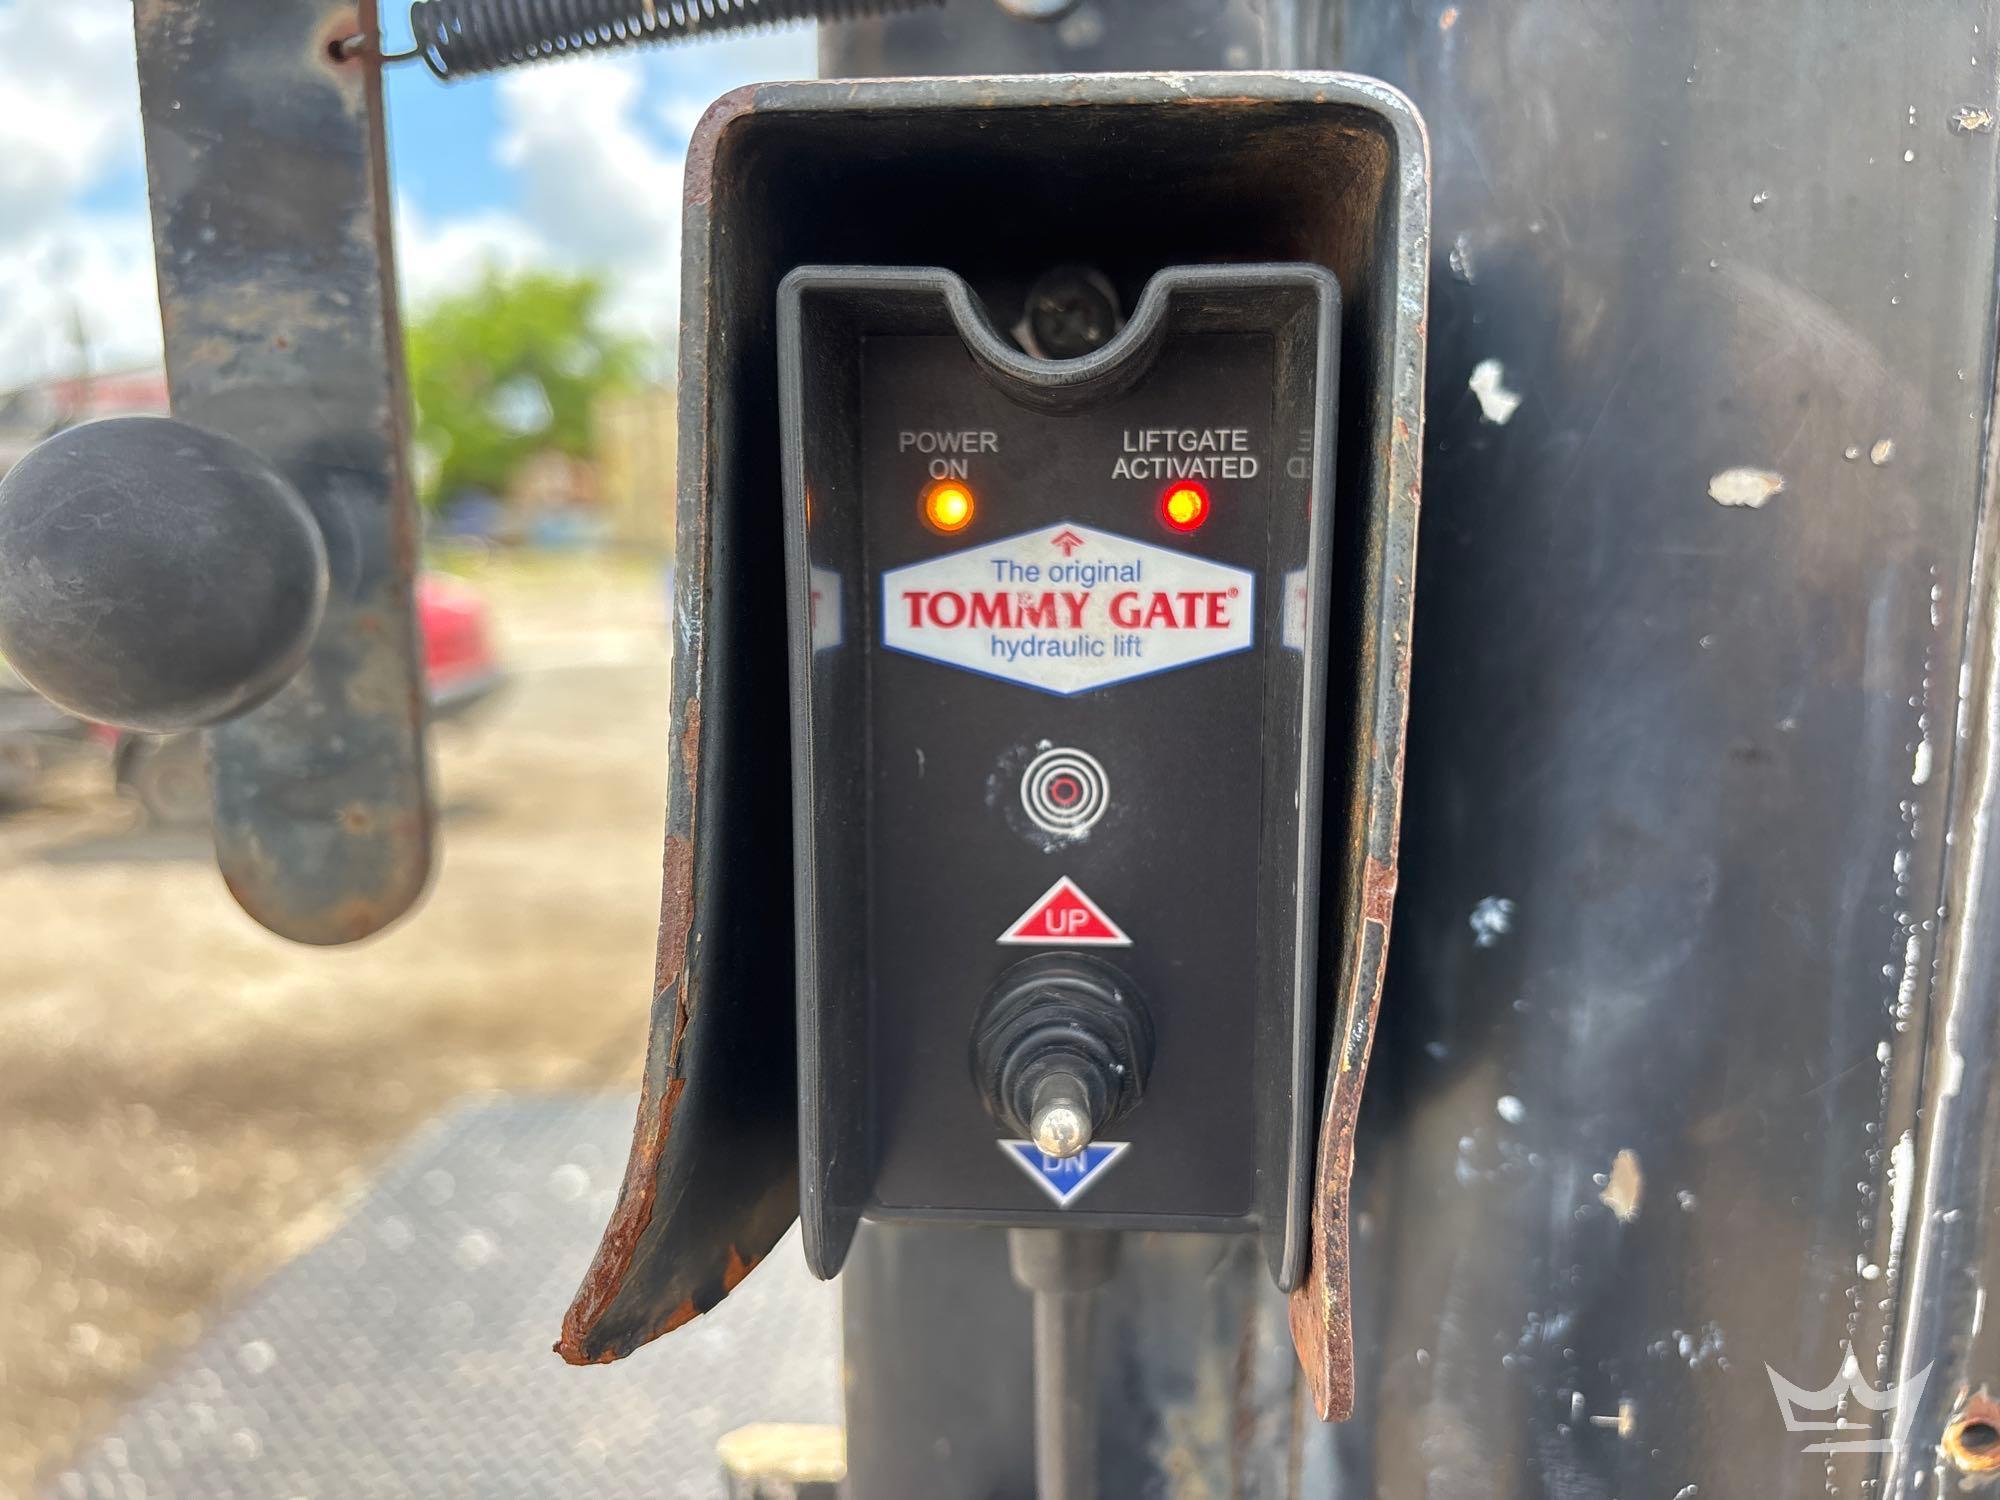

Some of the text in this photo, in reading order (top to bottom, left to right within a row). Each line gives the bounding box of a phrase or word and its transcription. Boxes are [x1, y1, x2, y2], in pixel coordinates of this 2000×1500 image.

[900, 431, 998, 453] POWER
[1123, 430, 1248, 452] LIFTGATE
[929, 459, 968, 480] ON
[1111, 457, 1258, 480] ACTIVATED
[991, 560, 1141, 588] The original
[903, 591, 1090, 629] TOMMY
[991, 634, 1142, 662] hydraulic lift
[1045, 908, 1089, 934] UP
